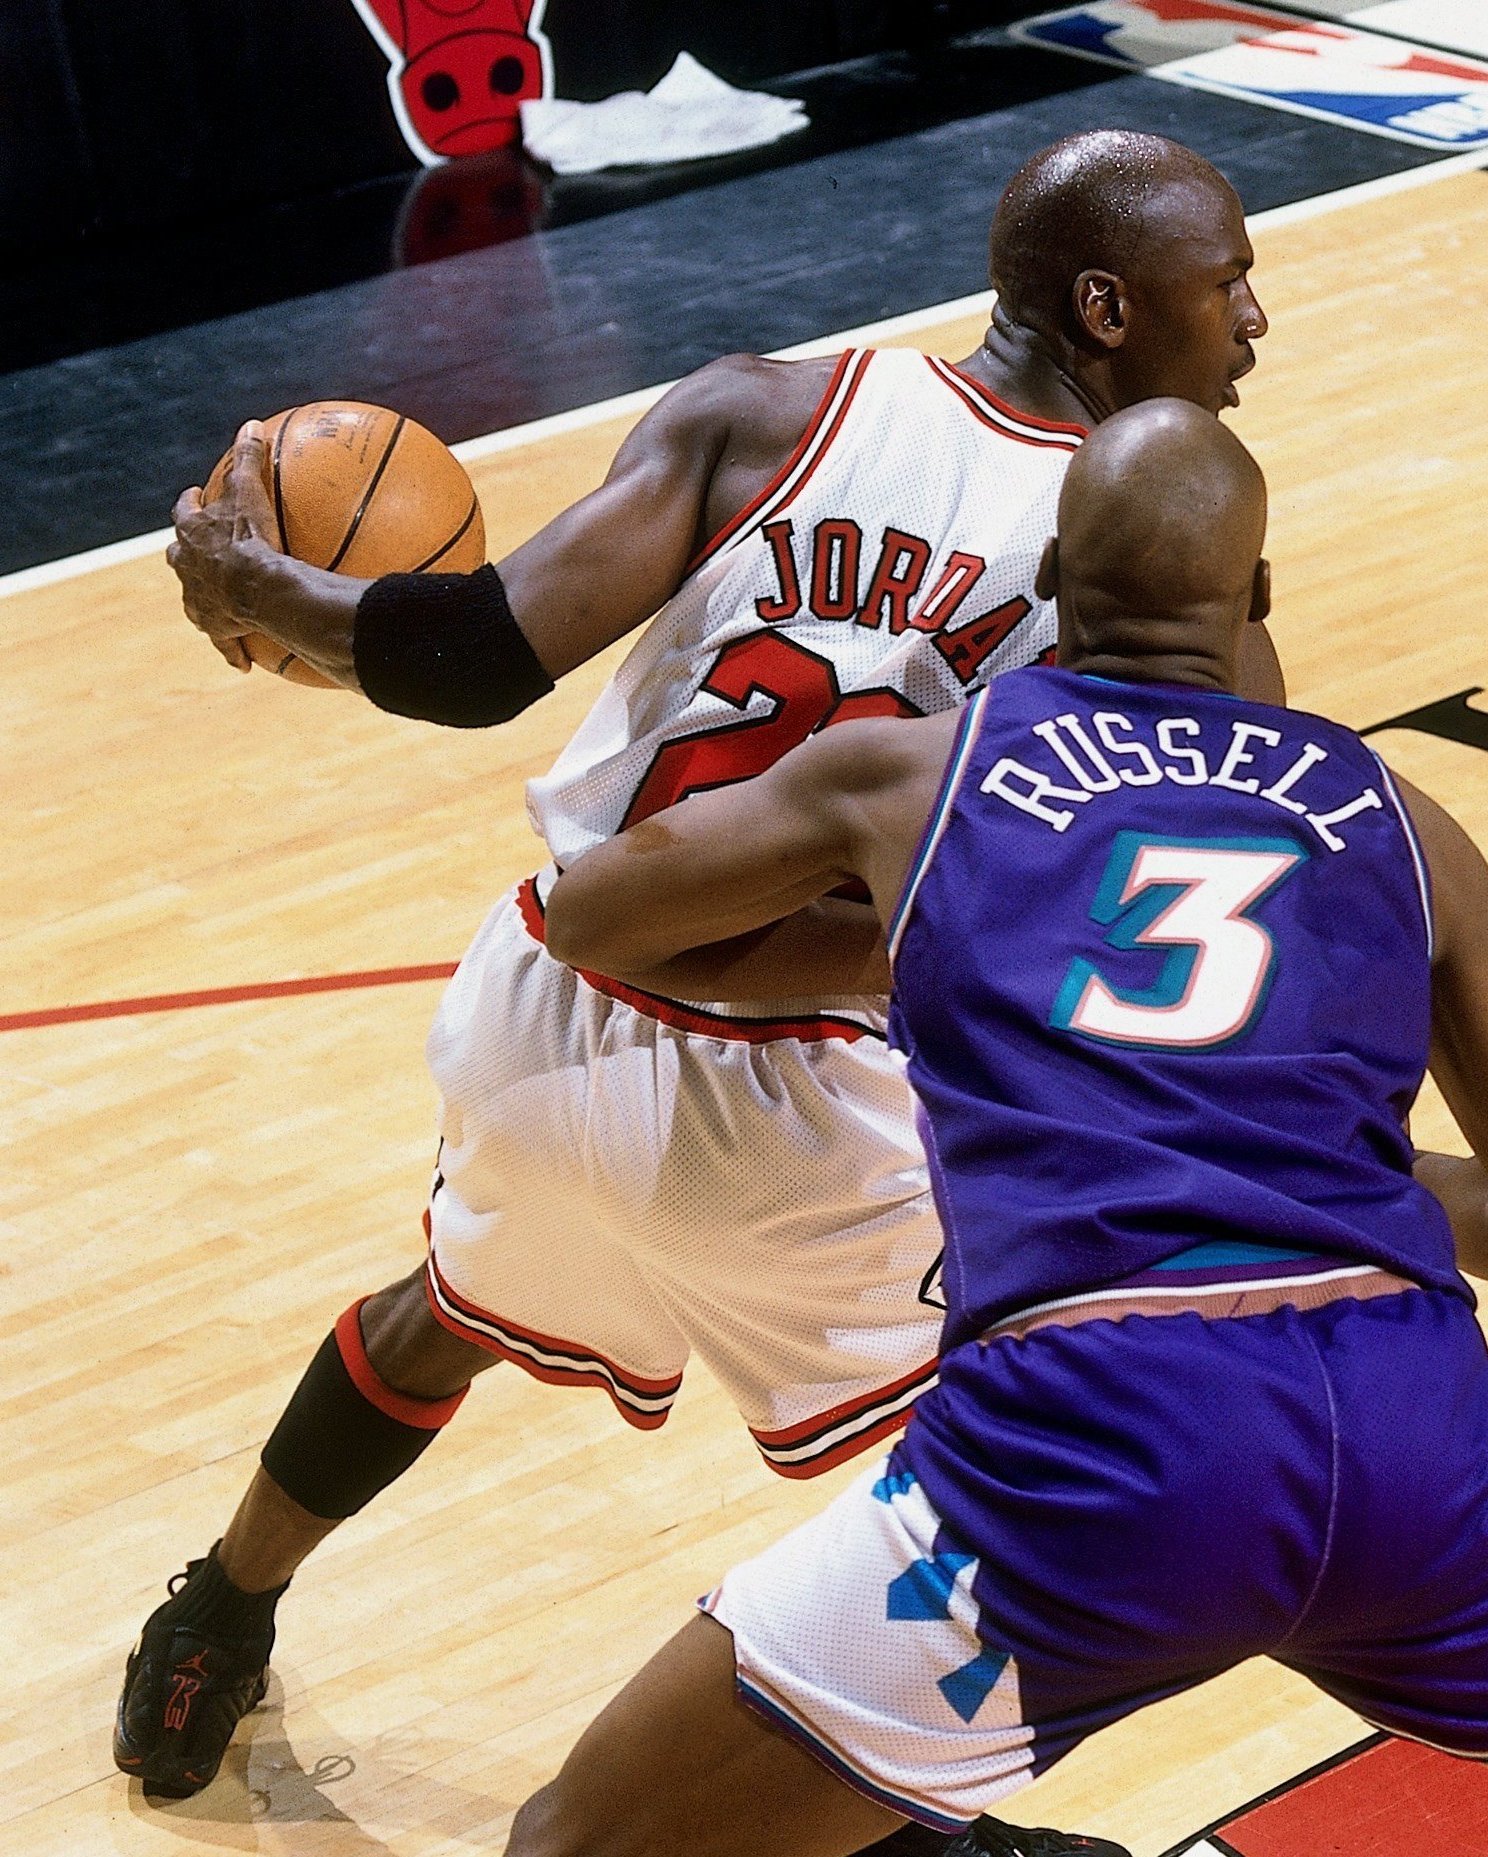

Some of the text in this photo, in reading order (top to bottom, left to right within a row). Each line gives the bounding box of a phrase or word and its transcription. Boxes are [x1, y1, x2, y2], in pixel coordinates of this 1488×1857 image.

[754, 518, 1058, 697] JORDA
[615, 627, 926, 836] 2
[979, 711, 1383, 853] RUSSELL
[1048, 829, 1311, 1053] 3
